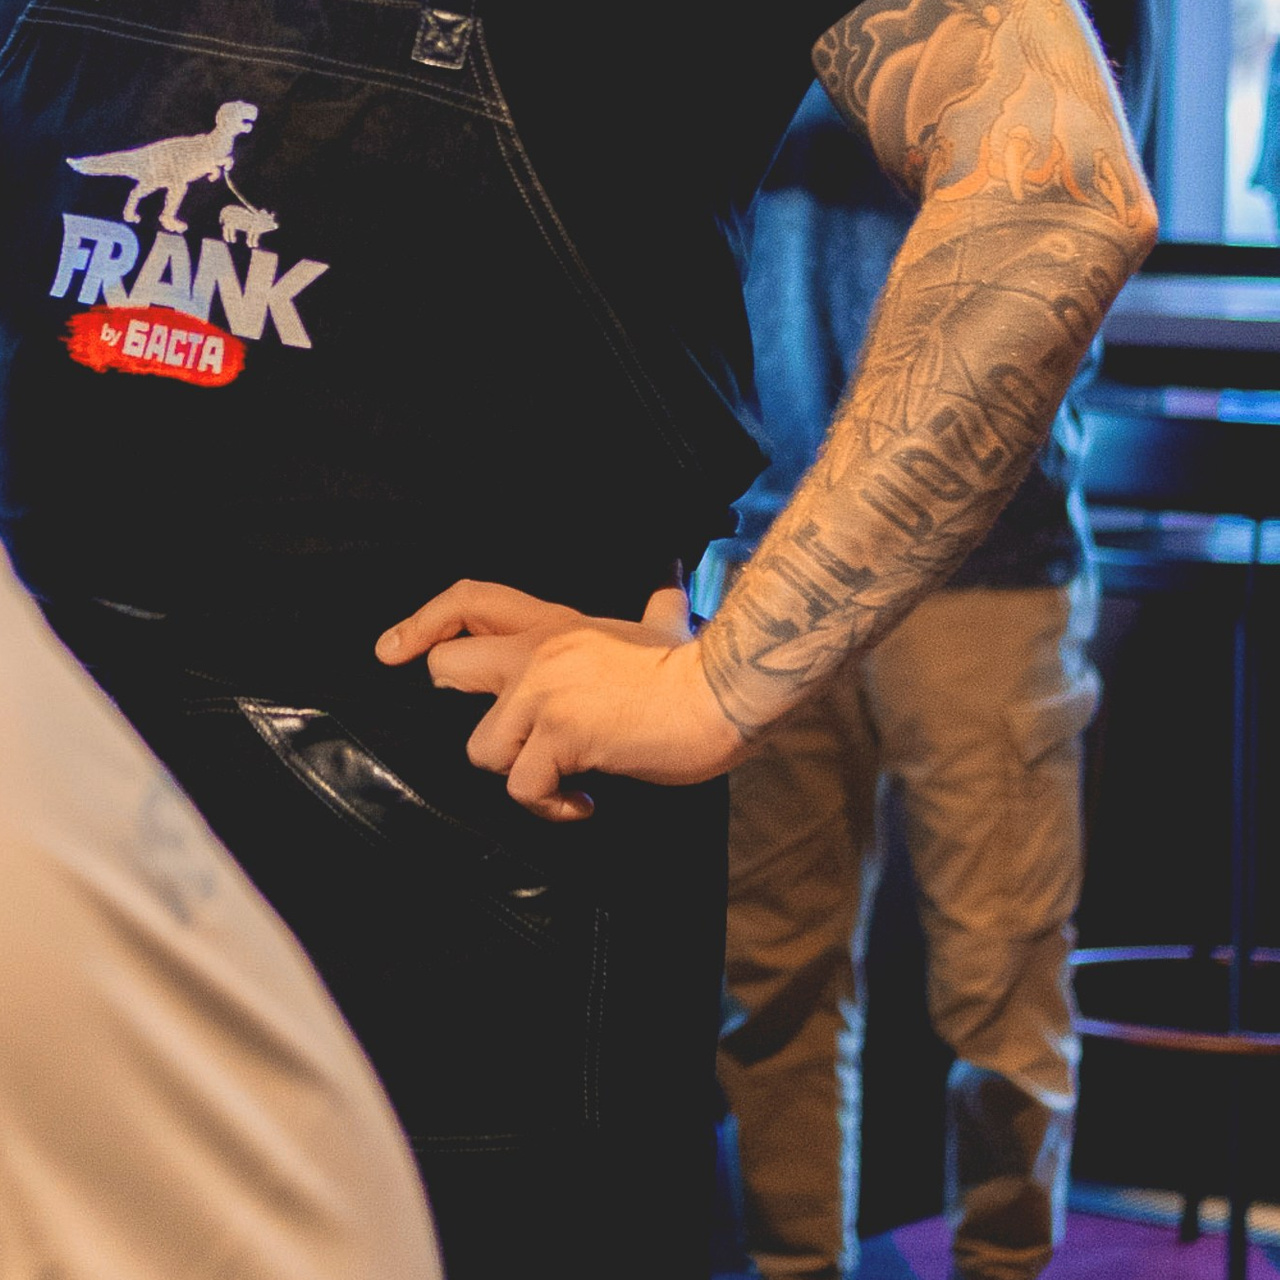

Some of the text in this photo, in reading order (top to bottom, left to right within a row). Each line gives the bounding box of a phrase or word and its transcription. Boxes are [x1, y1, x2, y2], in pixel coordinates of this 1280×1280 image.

[50, 213, 329, 348] FRANK
[100, 319, 225, 374] by БАСТА
